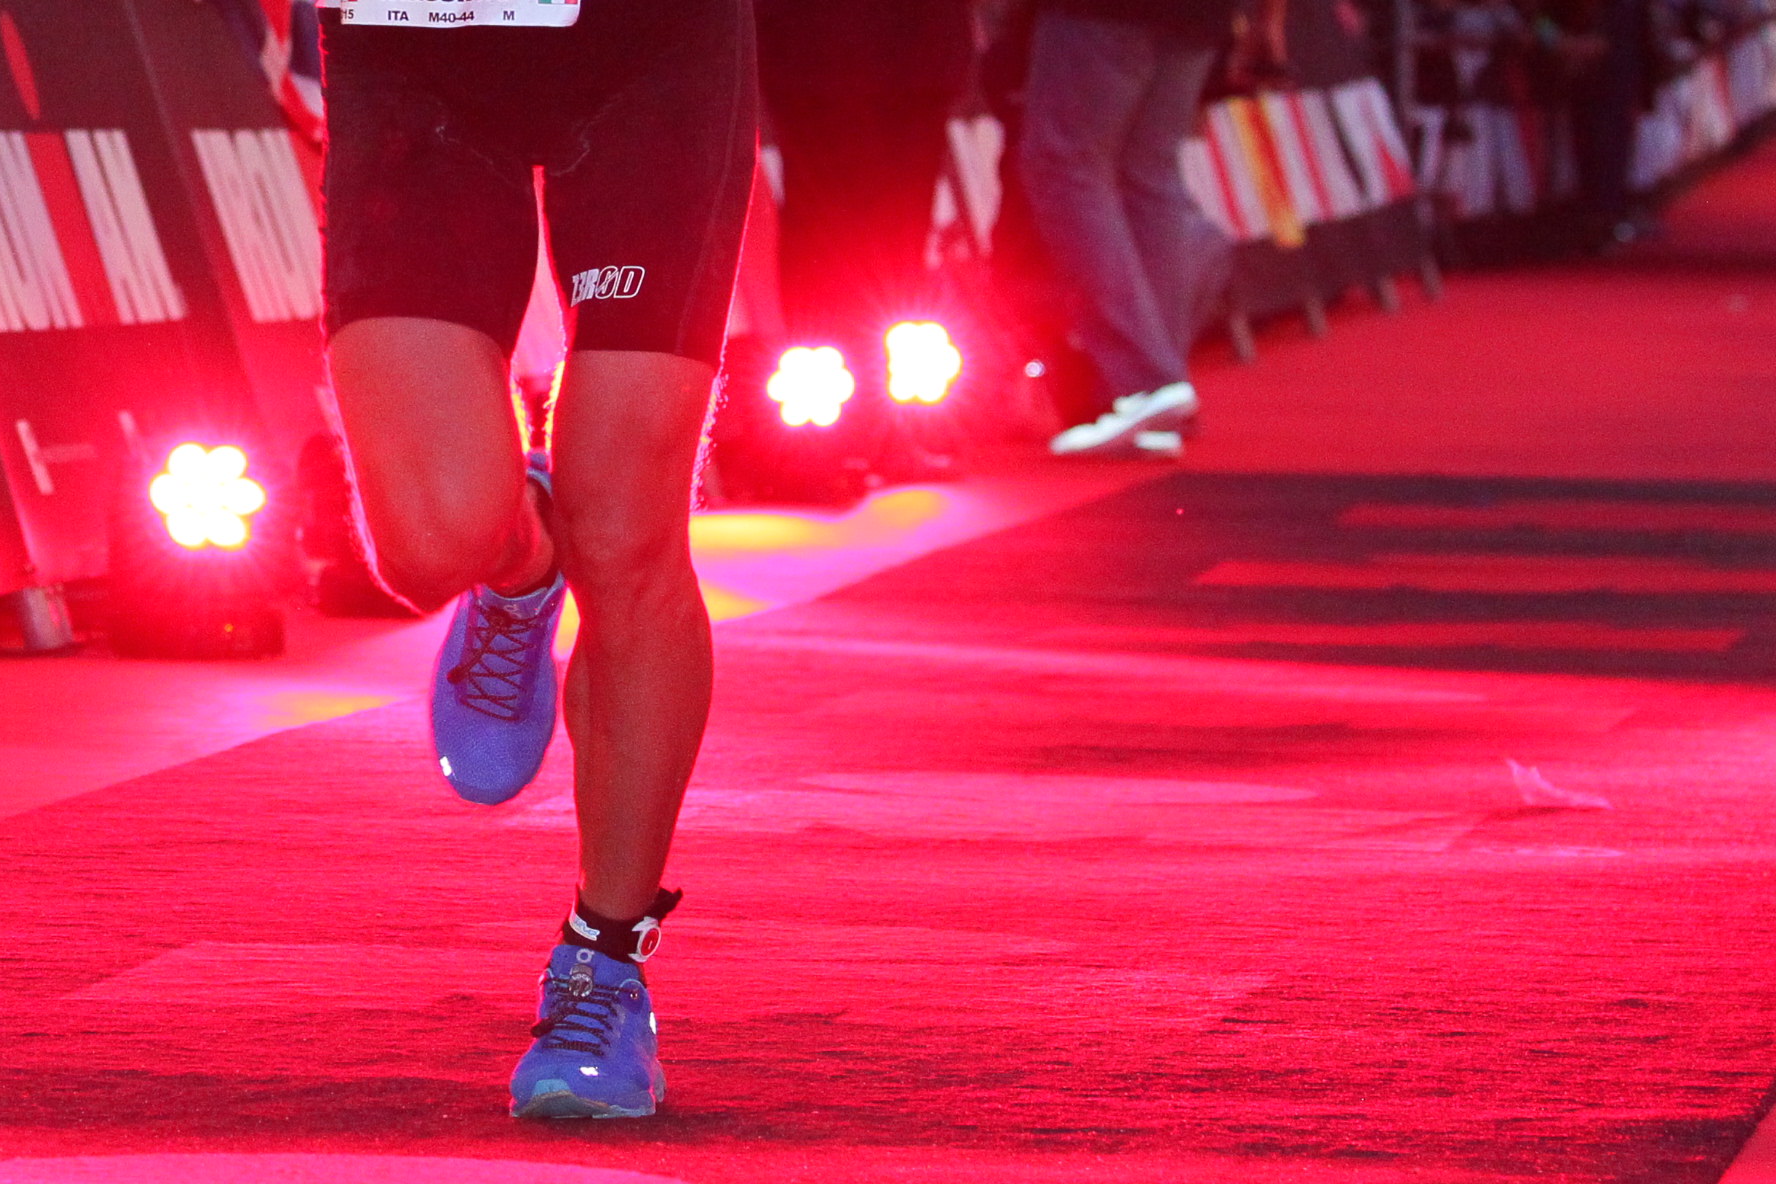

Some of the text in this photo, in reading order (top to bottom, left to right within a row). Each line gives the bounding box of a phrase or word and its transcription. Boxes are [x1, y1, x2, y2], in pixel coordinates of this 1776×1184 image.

[387, 10, 409, 21] ITA
[428, 11, 475, 23] M40-44
[502, 11, 515, 21] M
